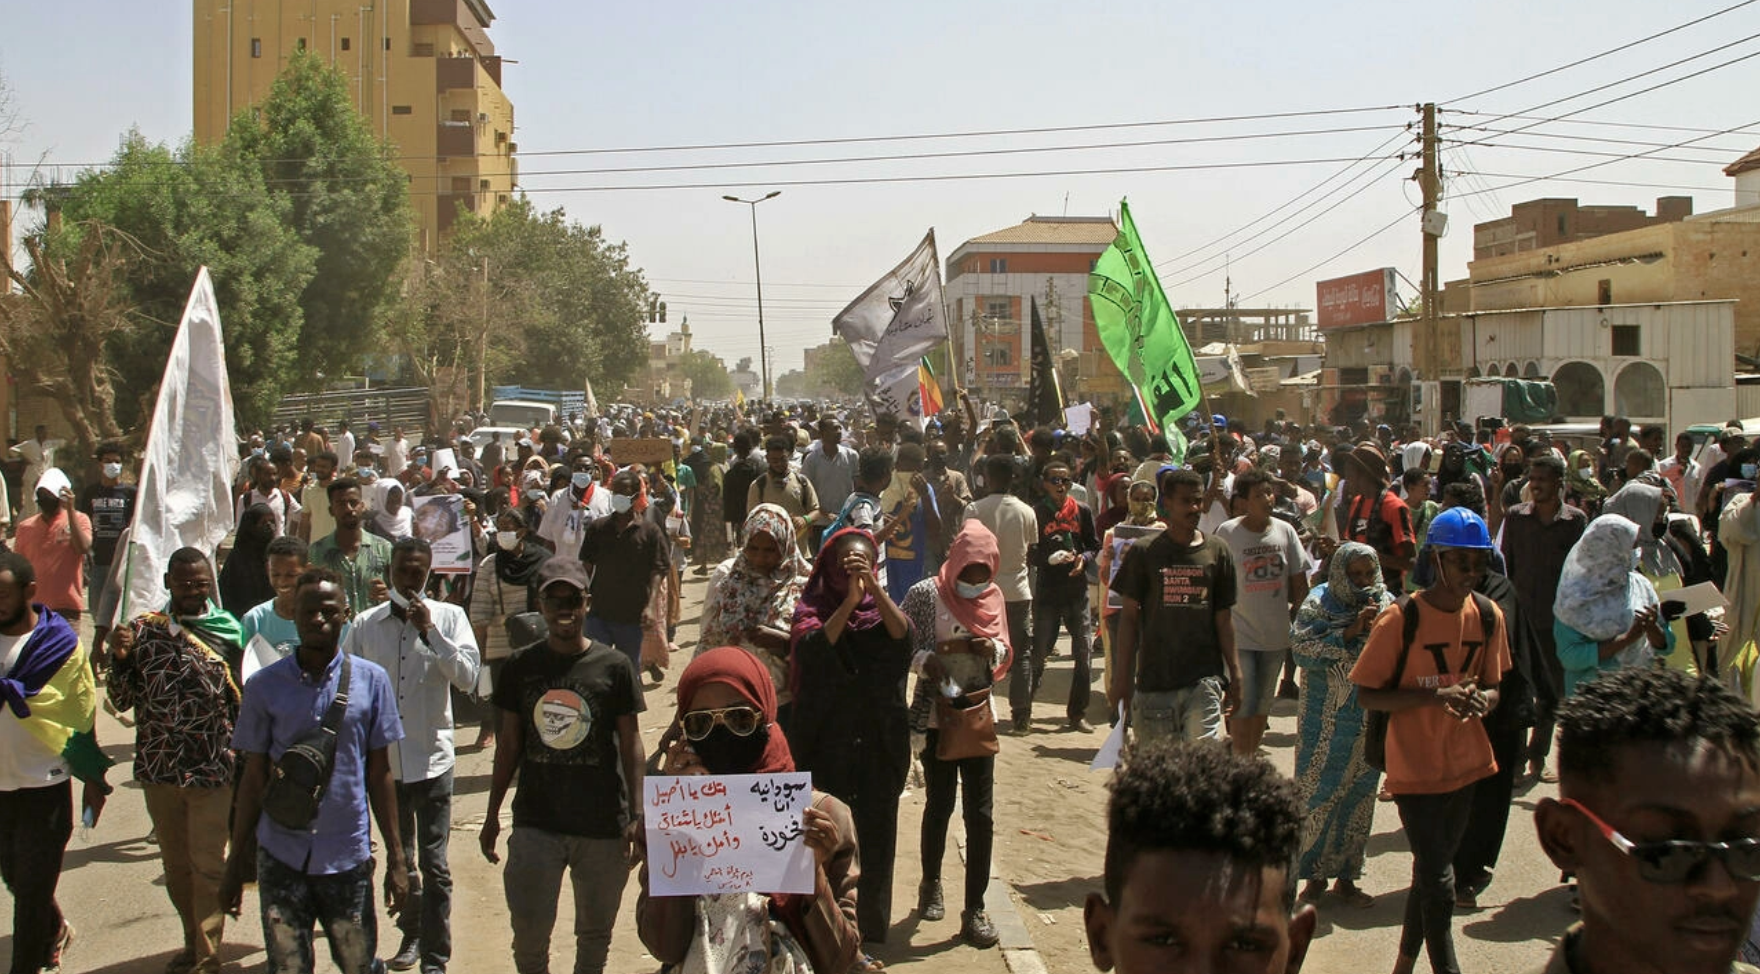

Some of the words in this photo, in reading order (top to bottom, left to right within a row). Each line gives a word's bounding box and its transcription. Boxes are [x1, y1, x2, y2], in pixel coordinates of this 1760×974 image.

[1182, 594, 1190, 603] 2
[688, 782, 700, 800] يا
[688, 837, 699, 856] يا
